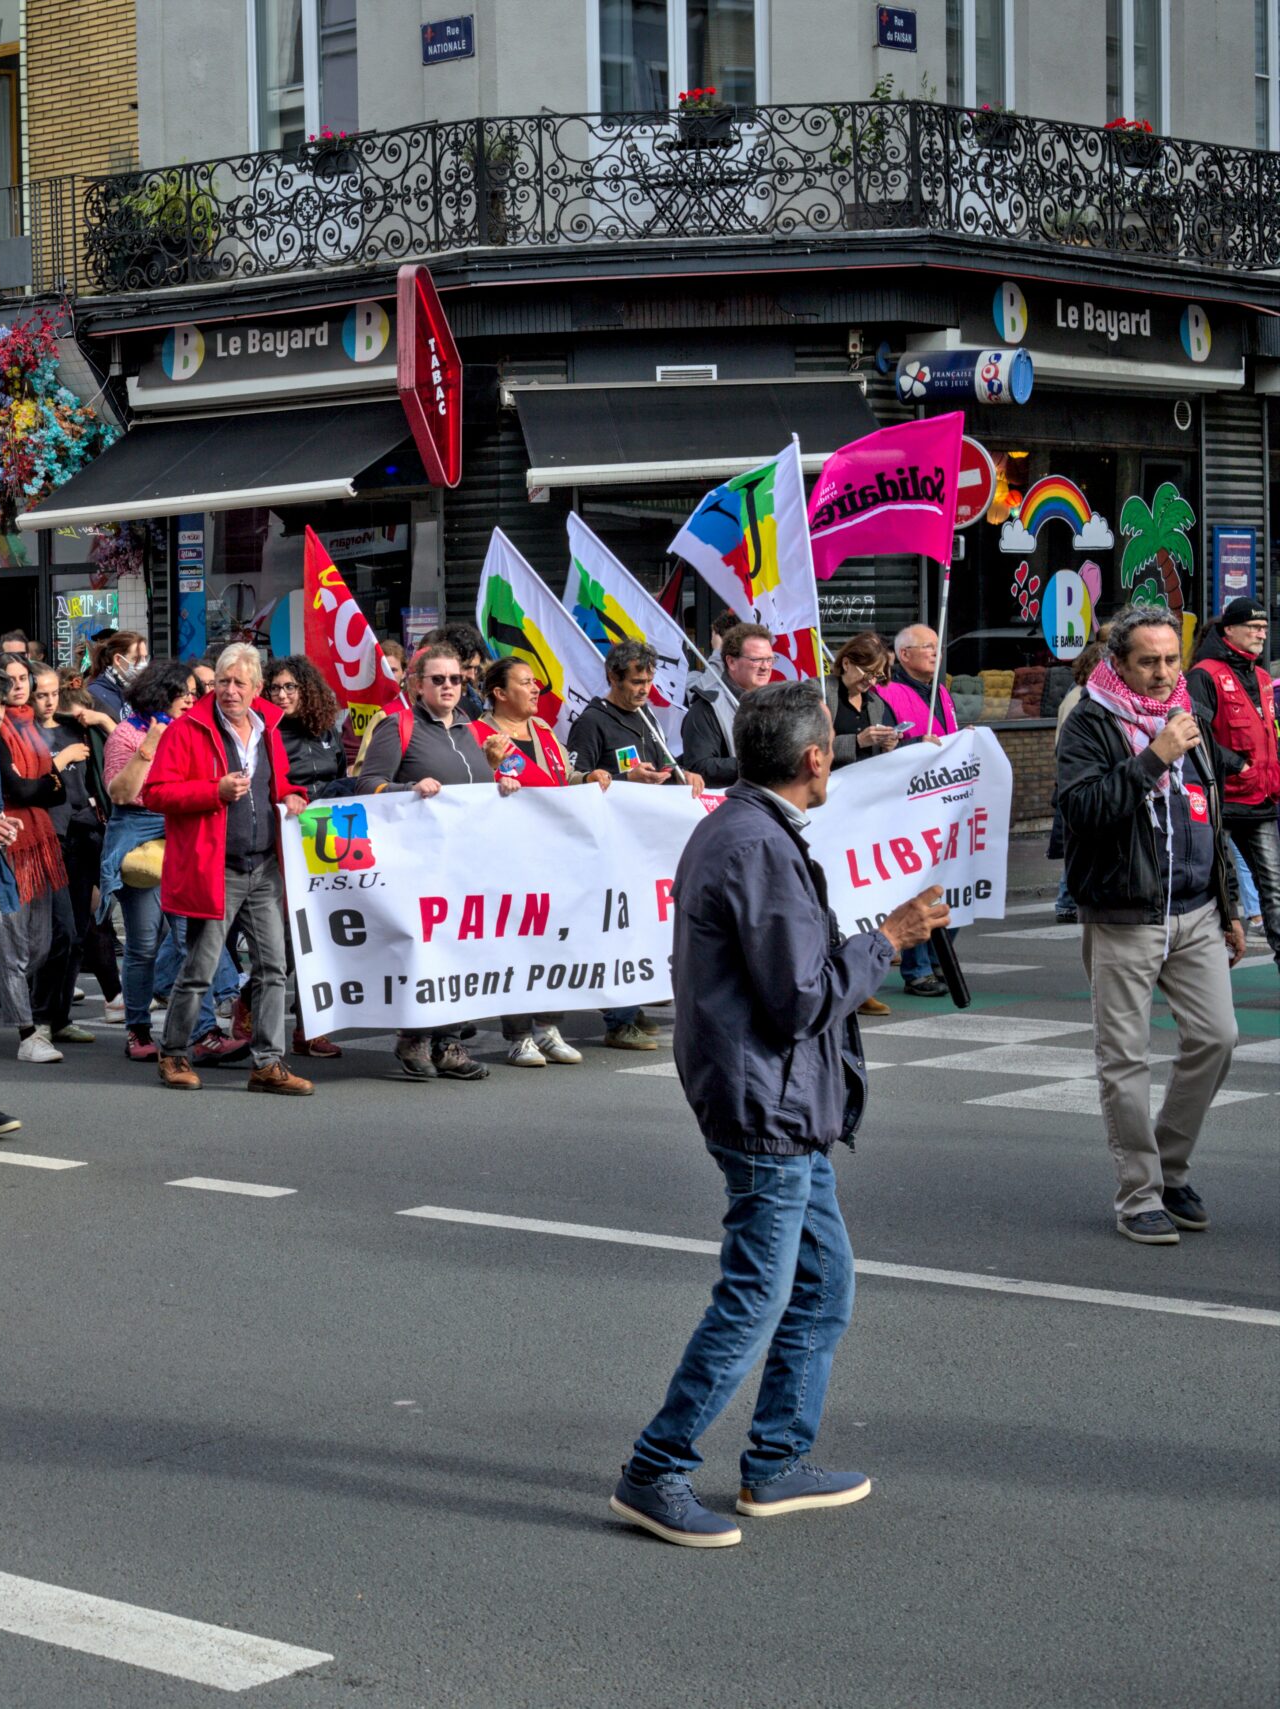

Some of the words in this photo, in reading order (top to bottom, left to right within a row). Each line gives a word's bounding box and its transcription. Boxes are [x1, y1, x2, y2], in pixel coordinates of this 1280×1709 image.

[893, 15, 904, 27] Rue
[446, 26, 460, 36] Rue
[894, 31, 912, 43] FAISAN
[428, 39, 466, 55] NATIONALE
[1056, 298, 1079, 328] Le
[1083, 302, 1151, 341] Bayard
[216, 332, 241, 357] Le
[247, 321, 329, 358] Bayard
[428, 338, 447, 416] TABAC
[932, 370, 973, 380] FRANÇAISE
[951, 380, 970, 388] JEUX
[1051, 635, 1059, 648] LE
[1060, 635, 1084, 648] BAYARD
[295, 907, 368, 956] le
[418, 892, 570, 942] PAIN,
[602, 888, 630, 933] la
[845, 806, 989, 890] LIBERTÉ
[307, 872, 386, 893] F.S.U.
[526, 961, 607, 992] POUR
[613, 957, 656, 987] les
